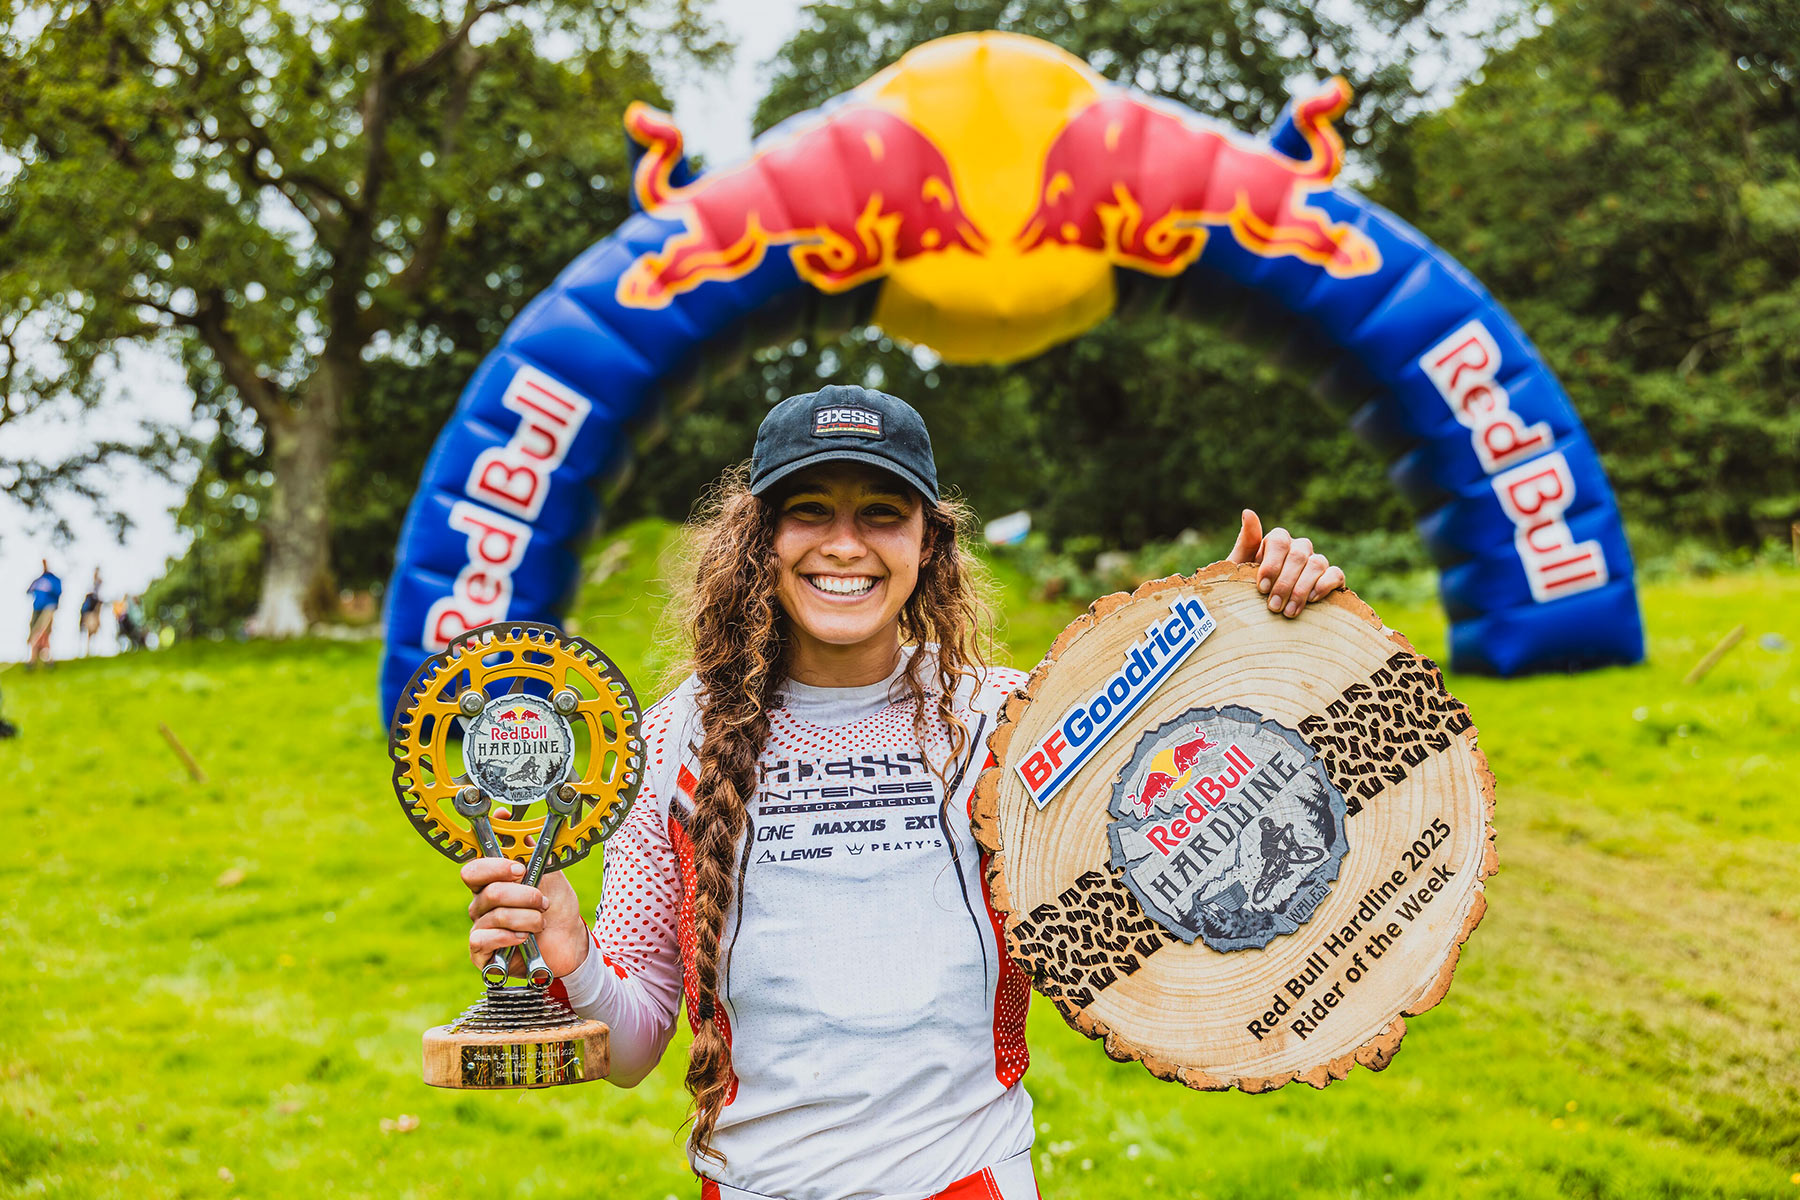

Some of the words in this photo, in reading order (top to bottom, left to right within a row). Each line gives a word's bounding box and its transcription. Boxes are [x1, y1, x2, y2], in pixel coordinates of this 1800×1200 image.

[817, 409, 879, 425] axess
[477, 379, 578, 508] Bull
[1434, 335, 1543, 461] Red
[1507, 466, 1598, 591] Bull
[1191, 619, 1213, 643] Tires
[1019, 599, 1206, 793] BFGoodrich
[478, 740, 559, 756] HARDLINE
[759, 781, 933, 802] INTENSE
[765, 802, 850, 814] FACTORY
[861, 797, 929, 808] RACING
[757, 824, 796, 842] ONE
[812, 818, 887, 836] MAXXIS
[904, 815, 938, 831] EXT
[1150, 750, 1300, 905] HARDLINE
[780, 846, 834, 862] LEWIS
[871, 839, 943, 852] PEATY'S
[1285, 881, 1330, 924] WALES
[1246, 994, 1292, 1041] Red
[1284, 952, 1330, 1000] Bull
[1322, 869, 1408, 958] Hardline
[1401, 817, 1452, 873] 2025
[1290, 981, 1346, 1041] Rider
[1345, 952, 1370, 984] of
[1365, 921, 1403, 960] the
[1394, 863, 1457, 923] Week
